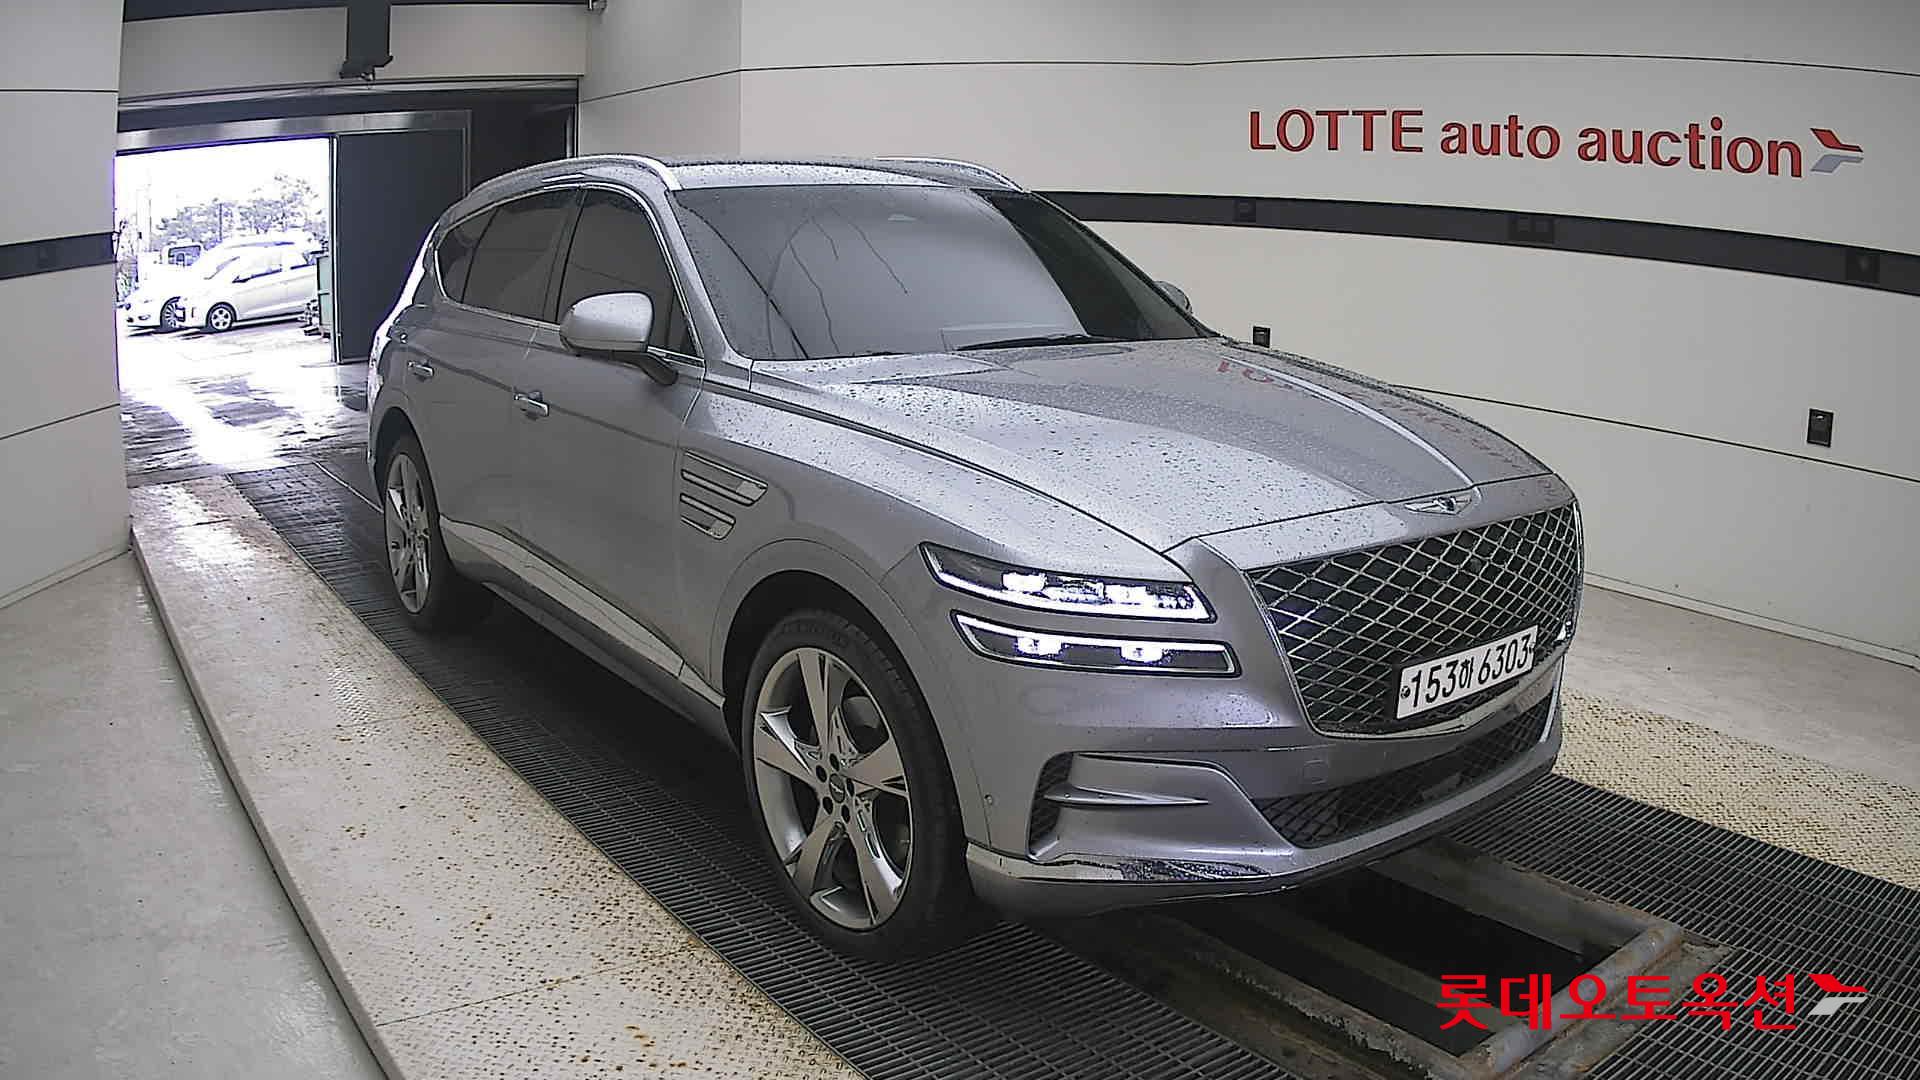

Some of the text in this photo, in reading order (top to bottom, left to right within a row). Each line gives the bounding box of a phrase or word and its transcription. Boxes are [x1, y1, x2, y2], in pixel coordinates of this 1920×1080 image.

[1249, 110, 1802, 178] LOTTE auto auction
[1477, 633, 1532, 685] 6303
